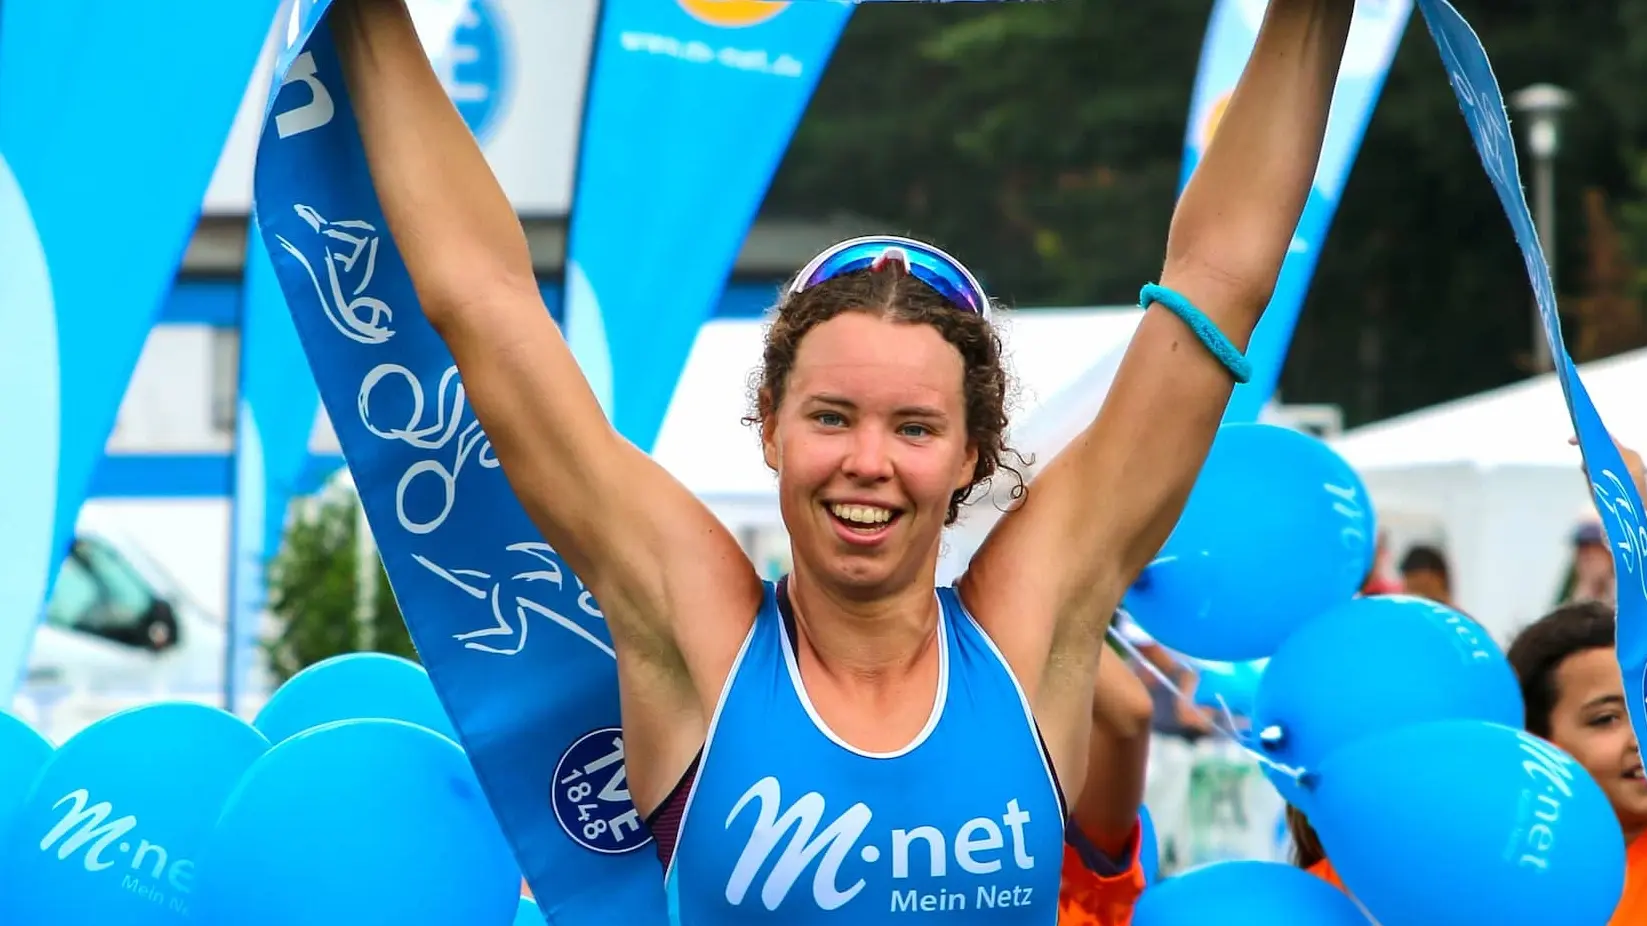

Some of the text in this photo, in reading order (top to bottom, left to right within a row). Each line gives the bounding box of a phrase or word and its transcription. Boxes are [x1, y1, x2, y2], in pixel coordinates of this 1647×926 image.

[561, 769, 607, 840] 1848
[40, 788, 195, 894] M·ne
[121, 874, 165, 906] Mein
[890, 885, 1033, 912] Mein Netz
